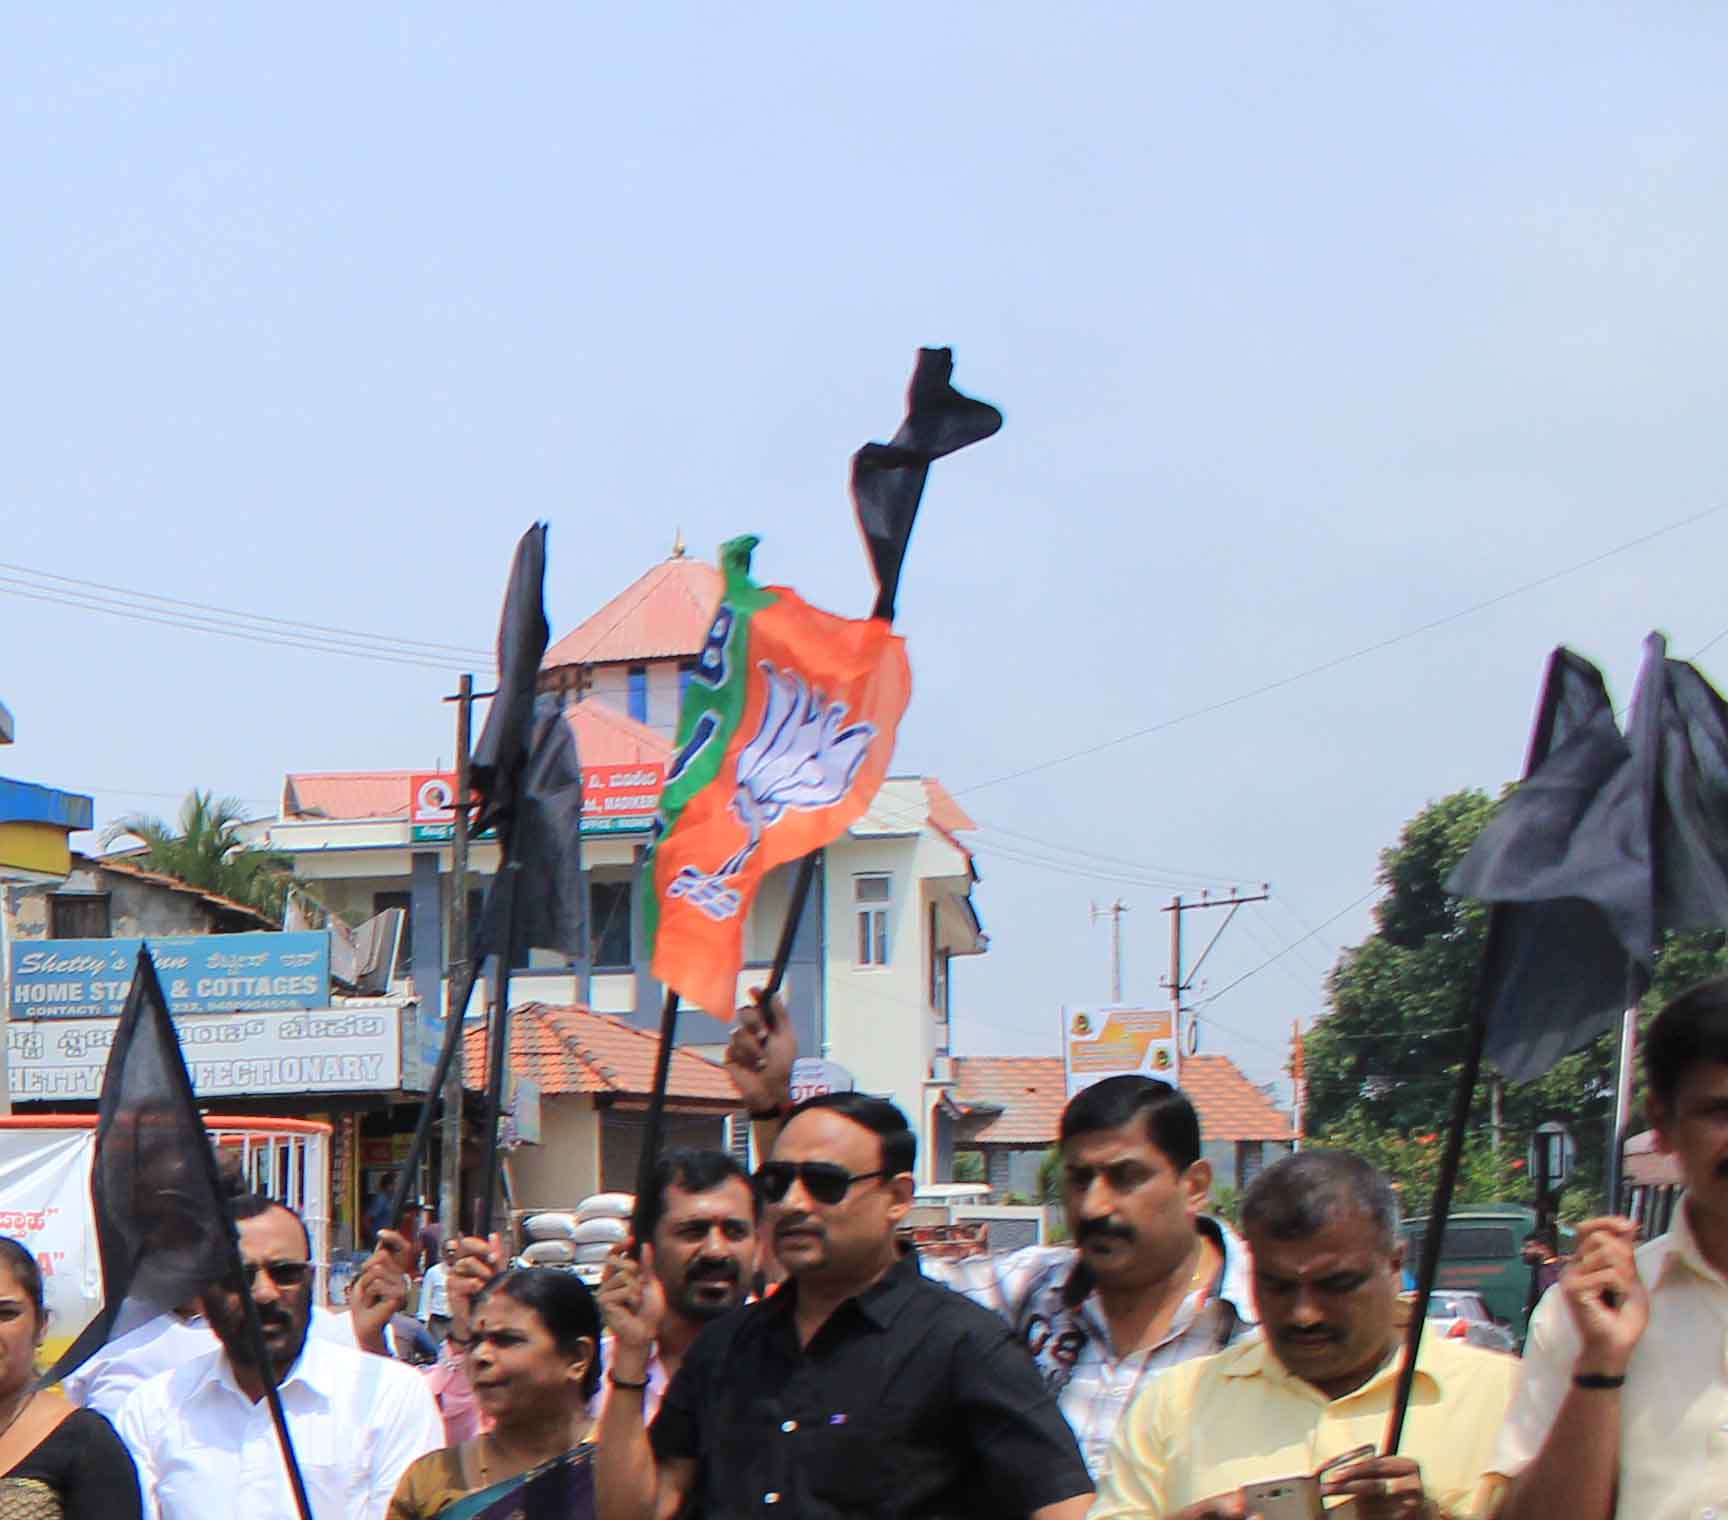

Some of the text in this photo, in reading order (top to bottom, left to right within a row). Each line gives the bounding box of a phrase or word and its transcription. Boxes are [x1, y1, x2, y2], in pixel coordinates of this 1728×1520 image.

[16, 949, 128, 976] Shetty's
[14, 975, 319, 1004] HOME STA & COTTAGES
[8, 1052, 385, 1094] HETTY FECTIONARY
